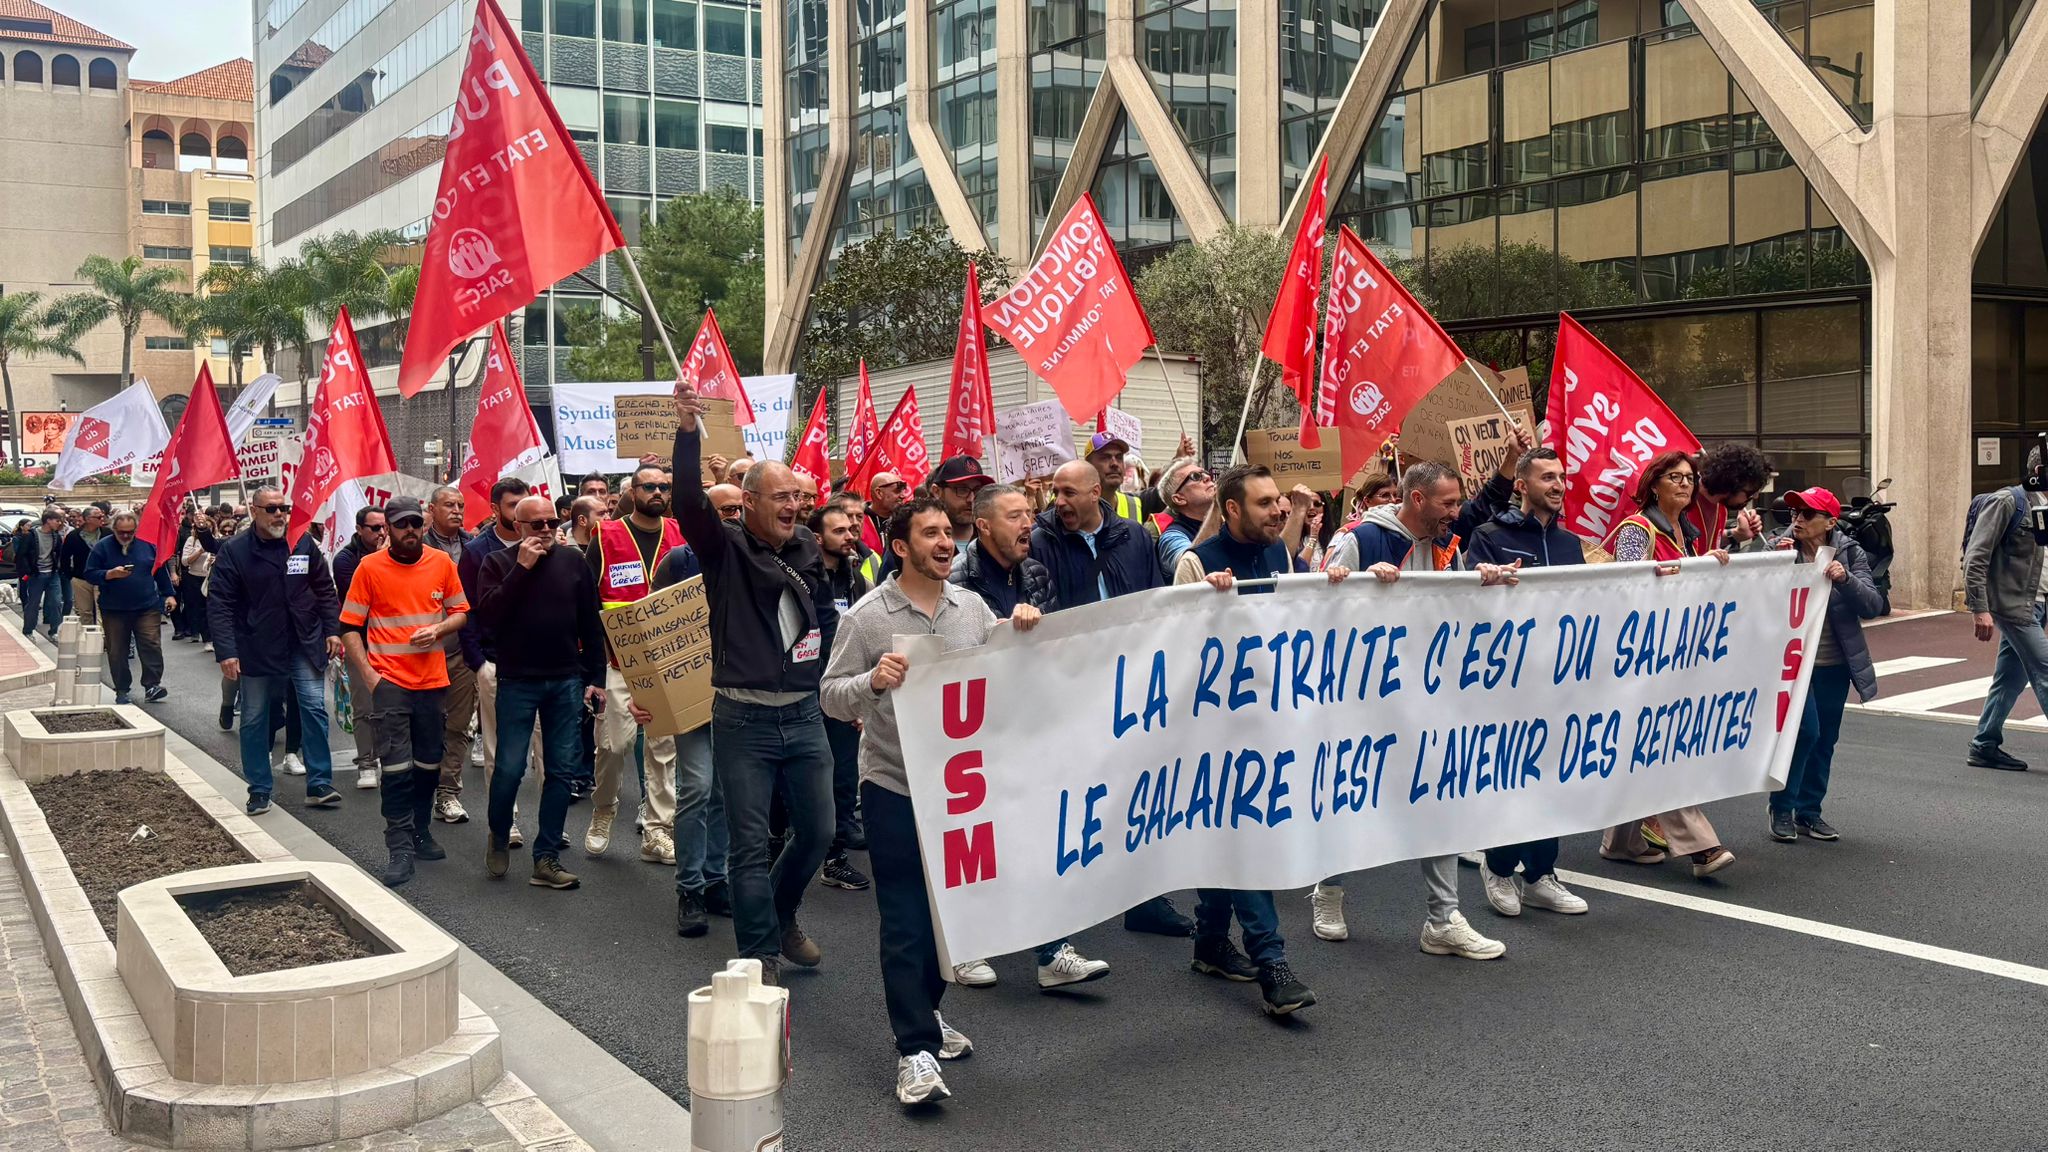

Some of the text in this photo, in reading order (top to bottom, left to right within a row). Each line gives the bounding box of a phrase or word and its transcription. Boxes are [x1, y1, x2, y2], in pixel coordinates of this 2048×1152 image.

[1498, 383, 1531, 406] ONNEL
[773, 396, 793, 412] du
[620, 429, 676, 441] NOS MÉTIE
[1274, 451, 1293, 460] NOS
[1274, 460, 1321, 472] RETRAITES
[621, 623, 712, 668] LA PENIBILIT
[1114, 601, 1737, 738] LA RETRAITE C'EST DU SALAIRE
[631, 676, 654, 691] NOS
[1057, 688, 1758, 876] LE SALAIRE C'EST L'AVENIR DES RETRAITES
